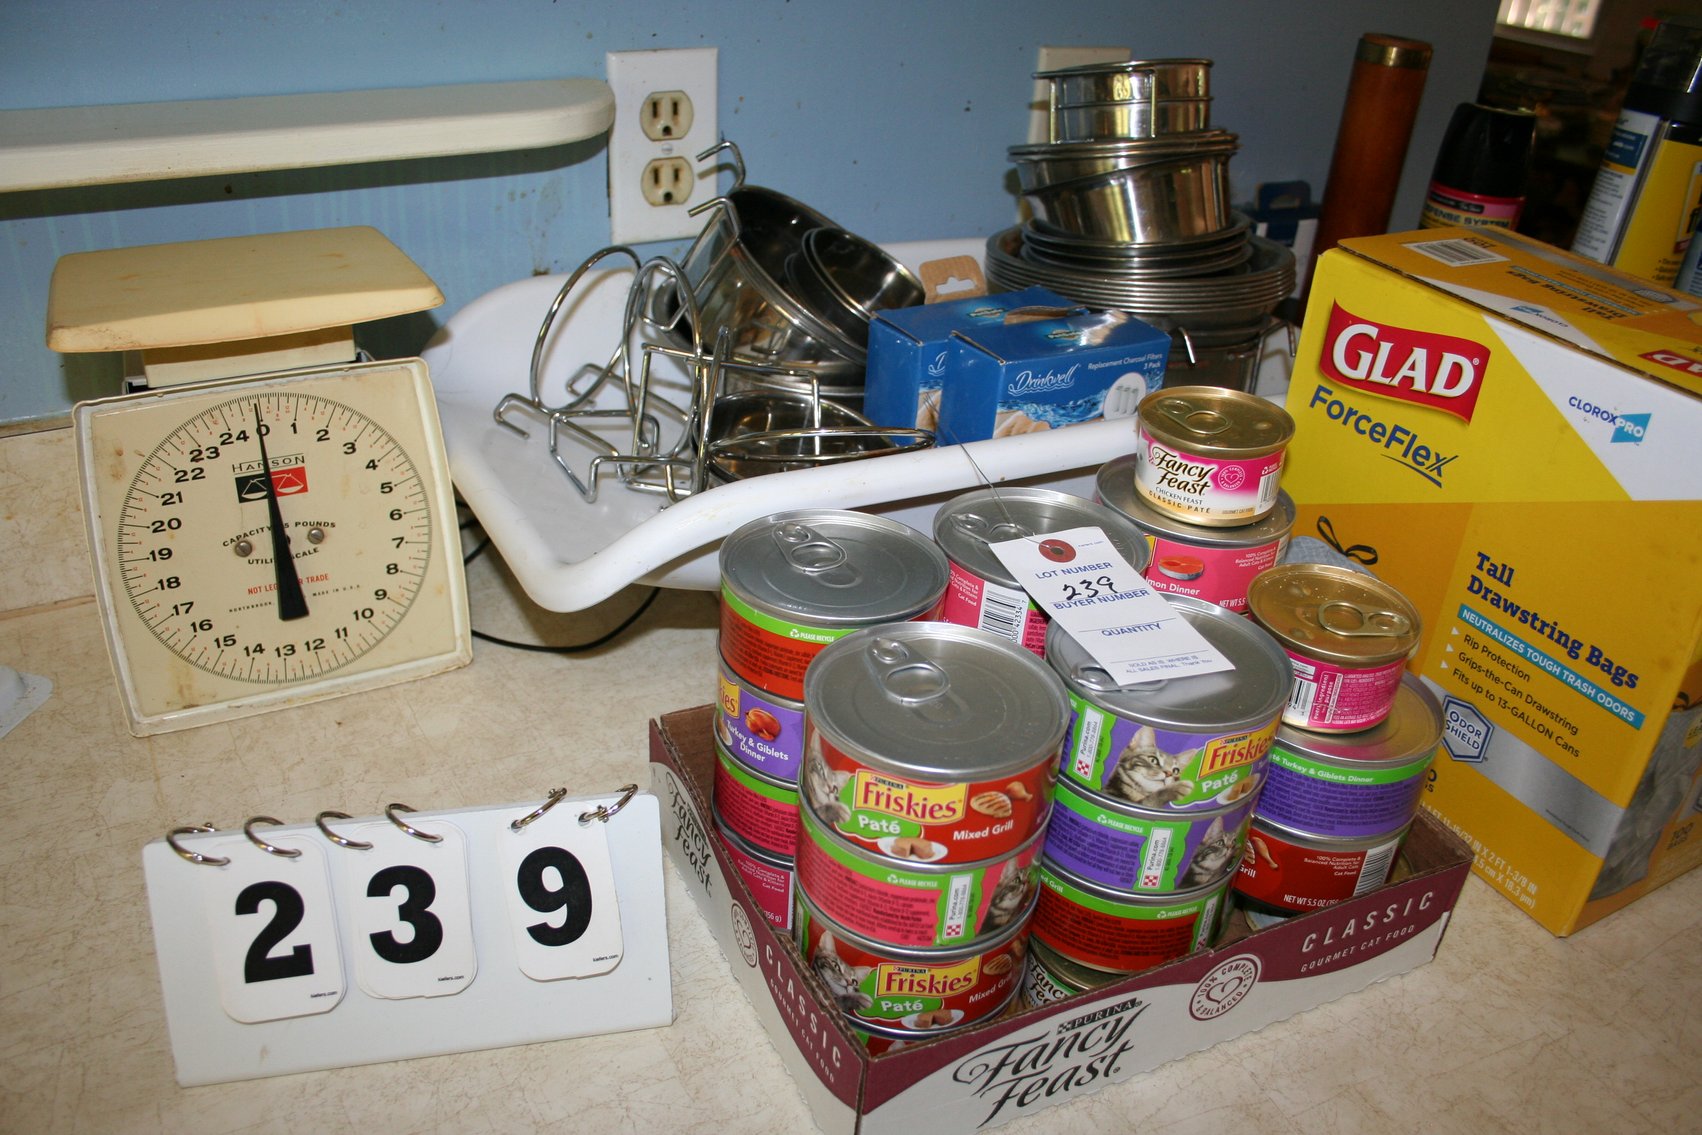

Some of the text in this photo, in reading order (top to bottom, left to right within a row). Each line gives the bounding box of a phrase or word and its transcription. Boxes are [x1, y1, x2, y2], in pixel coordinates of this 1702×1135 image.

[1087, 352, 1163, 370] Replacement Charcoal Filters
[1149, 361, 1161, 369] Pack
[1332, 323, 1475, 398] GLAD
[1008, 363, 1080, 397] Drinkwell
[219, 429, 250, 446] 24
[256, 423, 270, 437] 0
[291, 422, 298, 434] 1
[316, 429, 330, 442] 2
[1309, 384, 1460, 478] ForceFlex
[189, 446, 221, 462] 23
[342, 442, 357, 455] 3
[365, 459, 379, 471] 4
[1152, 446, 1215, 482] Fancy
[174, 467, 206, 483] 22
[1156, 466, 1211, 496] Feast
[380, 481, 393, 494] 5
[1155, 486, 1203, 506] CHICKEN FEAST
[160, 491, 183, 506] 21
[1148, 490, 1182, 509] CLASSIC
[389, 508, 403, 521] 6
[151, 517, 182, 533] 20
[222, 520, 336, 547] CAPACITY POUNDS
[391, 537, 405, 549] 7
[149, 547, 173, 562] 19
[386, 563, 399, 575] 8
[1035, 561, 1113, 580] LOT NUMBER
[1477, 551, 1515, 588] Tall
[157, 576, 181, 590] 18
[247, 585, 263, 595] NOT
[306, 573, 330, 584] TRADE
[1062, 575, 1119, 601] 239
[1146, 576, 1201, 596] lmon Dinner
[374, 588, 387, 600] 9
[1053, 589, 1150, 610] BUYER NUMBER
[1219, 599, 1239, 608] NET WT
[172, 601, 194, 616] 17
[353, 607, 374, 621] 10
[190, 619, 213, 633] 16
[334, 627, 349, 639] 11
[1101, 622, 1162, 637] QUANTITY
[1467, 574, 1639, 689] Drawstring Bags
[214, 634, 237, 649] 15
[304, 638, 326, 651] 12
[800, 632, 834, 642] PLEASE RECYCLE
[243, 643, 265, 657] 14
[275, 644, 296, 658] 13
[1167, 655, 1190, 663] WHERE
[1463, 634, 1531, 683] Rip Protection
[1462, 608, 1636, 723] NEUTRALIZES TOUGH TRASH ODORS
[1458, 651, 1579, 737] Grips-the-Can Drawstring
[1452, 667, 1580, 758] Fits up to 13-GALLON Cans
[1449, 710, 1483, 740] ODOR
[726, 719, 789, 761] Turkey & Giblets
[1081, 720, 1092, 755] Purina.com
[1445, 720, 1480, 751] SHIELD
[740, 742, 766, 762] Dinner
[1281, 757, 1374, 783] Turkey & Giblets Dinner
[1201, 770, 1239, 793] Paté
[863, 781, 957, 820] Friskies
[665, 772, 711, 867] Fancy
[857, 814, 901, 834] Paté
[1107, 818, 1144, 834] PLEASE RECYCLE
[953, 819, 1014, 841] Mixed Grill
[674, 811, 712, 893] Feast
[1148, 839, 1160, 871] Purina.com
[1489, 851, 1495, 861] 2
[1495, 857, 1506, 869] FT
[899, 878, 917, 887] PLEASE
[1049, 879, 1064, 893] Grill
[949, 887, 961, 921] Purina.com
[1283, 893, 1327, 907] NET WT 5.5 OZ
[235, 846, 593, 984] 2 3 9
[1301, 891, 1434, 953] CLASSIC
[1300, 924, 1415, 973] GOURMET CAT FOOD
[897, 966, 927, 974] PURINA
[1197, 962, 1253, 998] 100% COMPLETE
[885, 969, 973, 994] Friskies
[968, 985, 996, 1004] Mixed
[1200, 991, 1243, 1016] BALANCED
[766, 944, 841, 1068] CLASSIC
[880, 1000, 924, 1013] Paté
[1073, 1001, 1133, 1028] PURINA
[770, 978, 835, 1083] GOURMET CAT FOOD
[953, 1003, 1151, 1097] Fancy
[976, 1039, 1135, 1129] Feast
